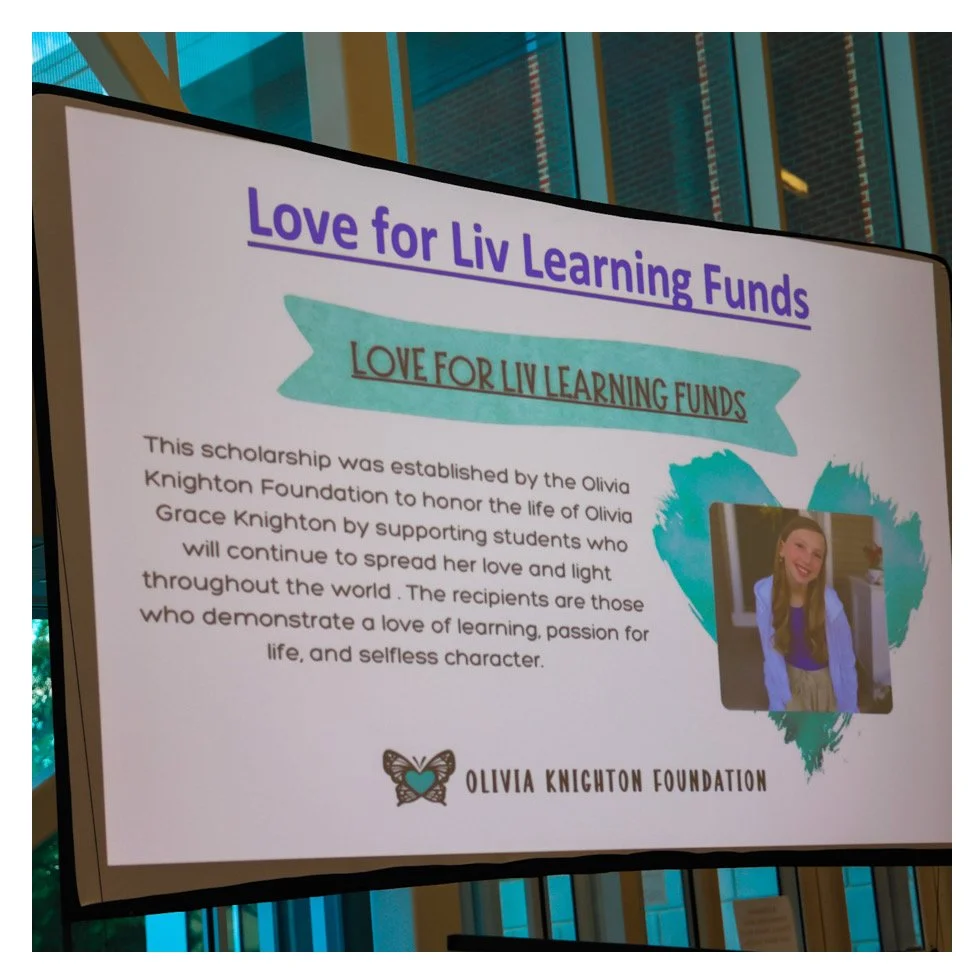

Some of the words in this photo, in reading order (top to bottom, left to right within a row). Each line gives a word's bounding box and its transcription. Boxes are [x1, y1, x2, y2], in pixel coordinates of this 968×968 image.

[248, 187, 358, 250] Love
[371, 205, 438, 261] for
[452, 221, 509, 273] Liv
[523, 233, 693, 311] Learning
[704, 263, 810, 320] Funds
[350, 341, 427, 382] LOVE
[434, 351, 494, 390] FOR
[501, 359, 536, 394] LIV
[544, 365, 668, 410] LEARNING
[674, 381, 747, 421] FUNDS
[143, 436, 194, 456] This
[201, 443, 331, 471] scholarship
[338, 457, 384, 473] was
[391, 461, 508, 483] established
[515, 470, 538, 490] by
[544, 472, 576, 489] the
[582, 476, 629, 494] Olivia
[145, 470, 252, 494] Knighton
[262, 479, 388, 504] Foundation
[395, 490, 416, 507] to
[423, 492, 482, 511] honor
[489, 498, 521, 515] the
[528, 500, 554, 518] life
[561, 504, 579, 519] of
[585, 506, 632, 524] Olivia
[156, 504, 226, 525] Grace
[234, 510, 336, 533] Knighton
[344, 517, 369, 538] by
[376, 522, 487, 547] supporting
[493, 529, 581, 549] students
[587, 536, 628, 552] who
[183, 541, 219, 557] will
[227, 545, 327, 564] continue
[335, 549, 357, 566] to
[364, 554, 436, 571] spread
[444, 555, 476, 572] her
[483, 558, 522, 575] love
[529, 563, 565, 578] and
[572, 564, 612, 583] light
[142, 571, 279, 596] throughout
[286, 578, 324, 596] the
[331, 583, 390, 599] world
[406, 585, 446, 602] The
[453, 589, 549, 608] recipients
[555, 596, 585, 609] are
[591, 595, 644, 612] those
[140, 606, 194, 624] who
[203, 608, 355, 630] demonstrate
[362, 618, 374, 631] a
[382, 615, 424, 633] love
[432, 617, 451, 633] of
[458, 618, 541, 641] learning,
[547, 626, 618, 641] passion
[625, 626, 649, 641] for
[268, 643, 303, 663] life,
[310, 646, 352, 662] and
[359, 647, 438, 665] selfless
[445, 650, 543, 668] character.
[466, 768, 535, 794] OLIVIA
[545, 768, 643, 793] KNIGHTON
[653, 768, 767, 793] FOUNDATION
